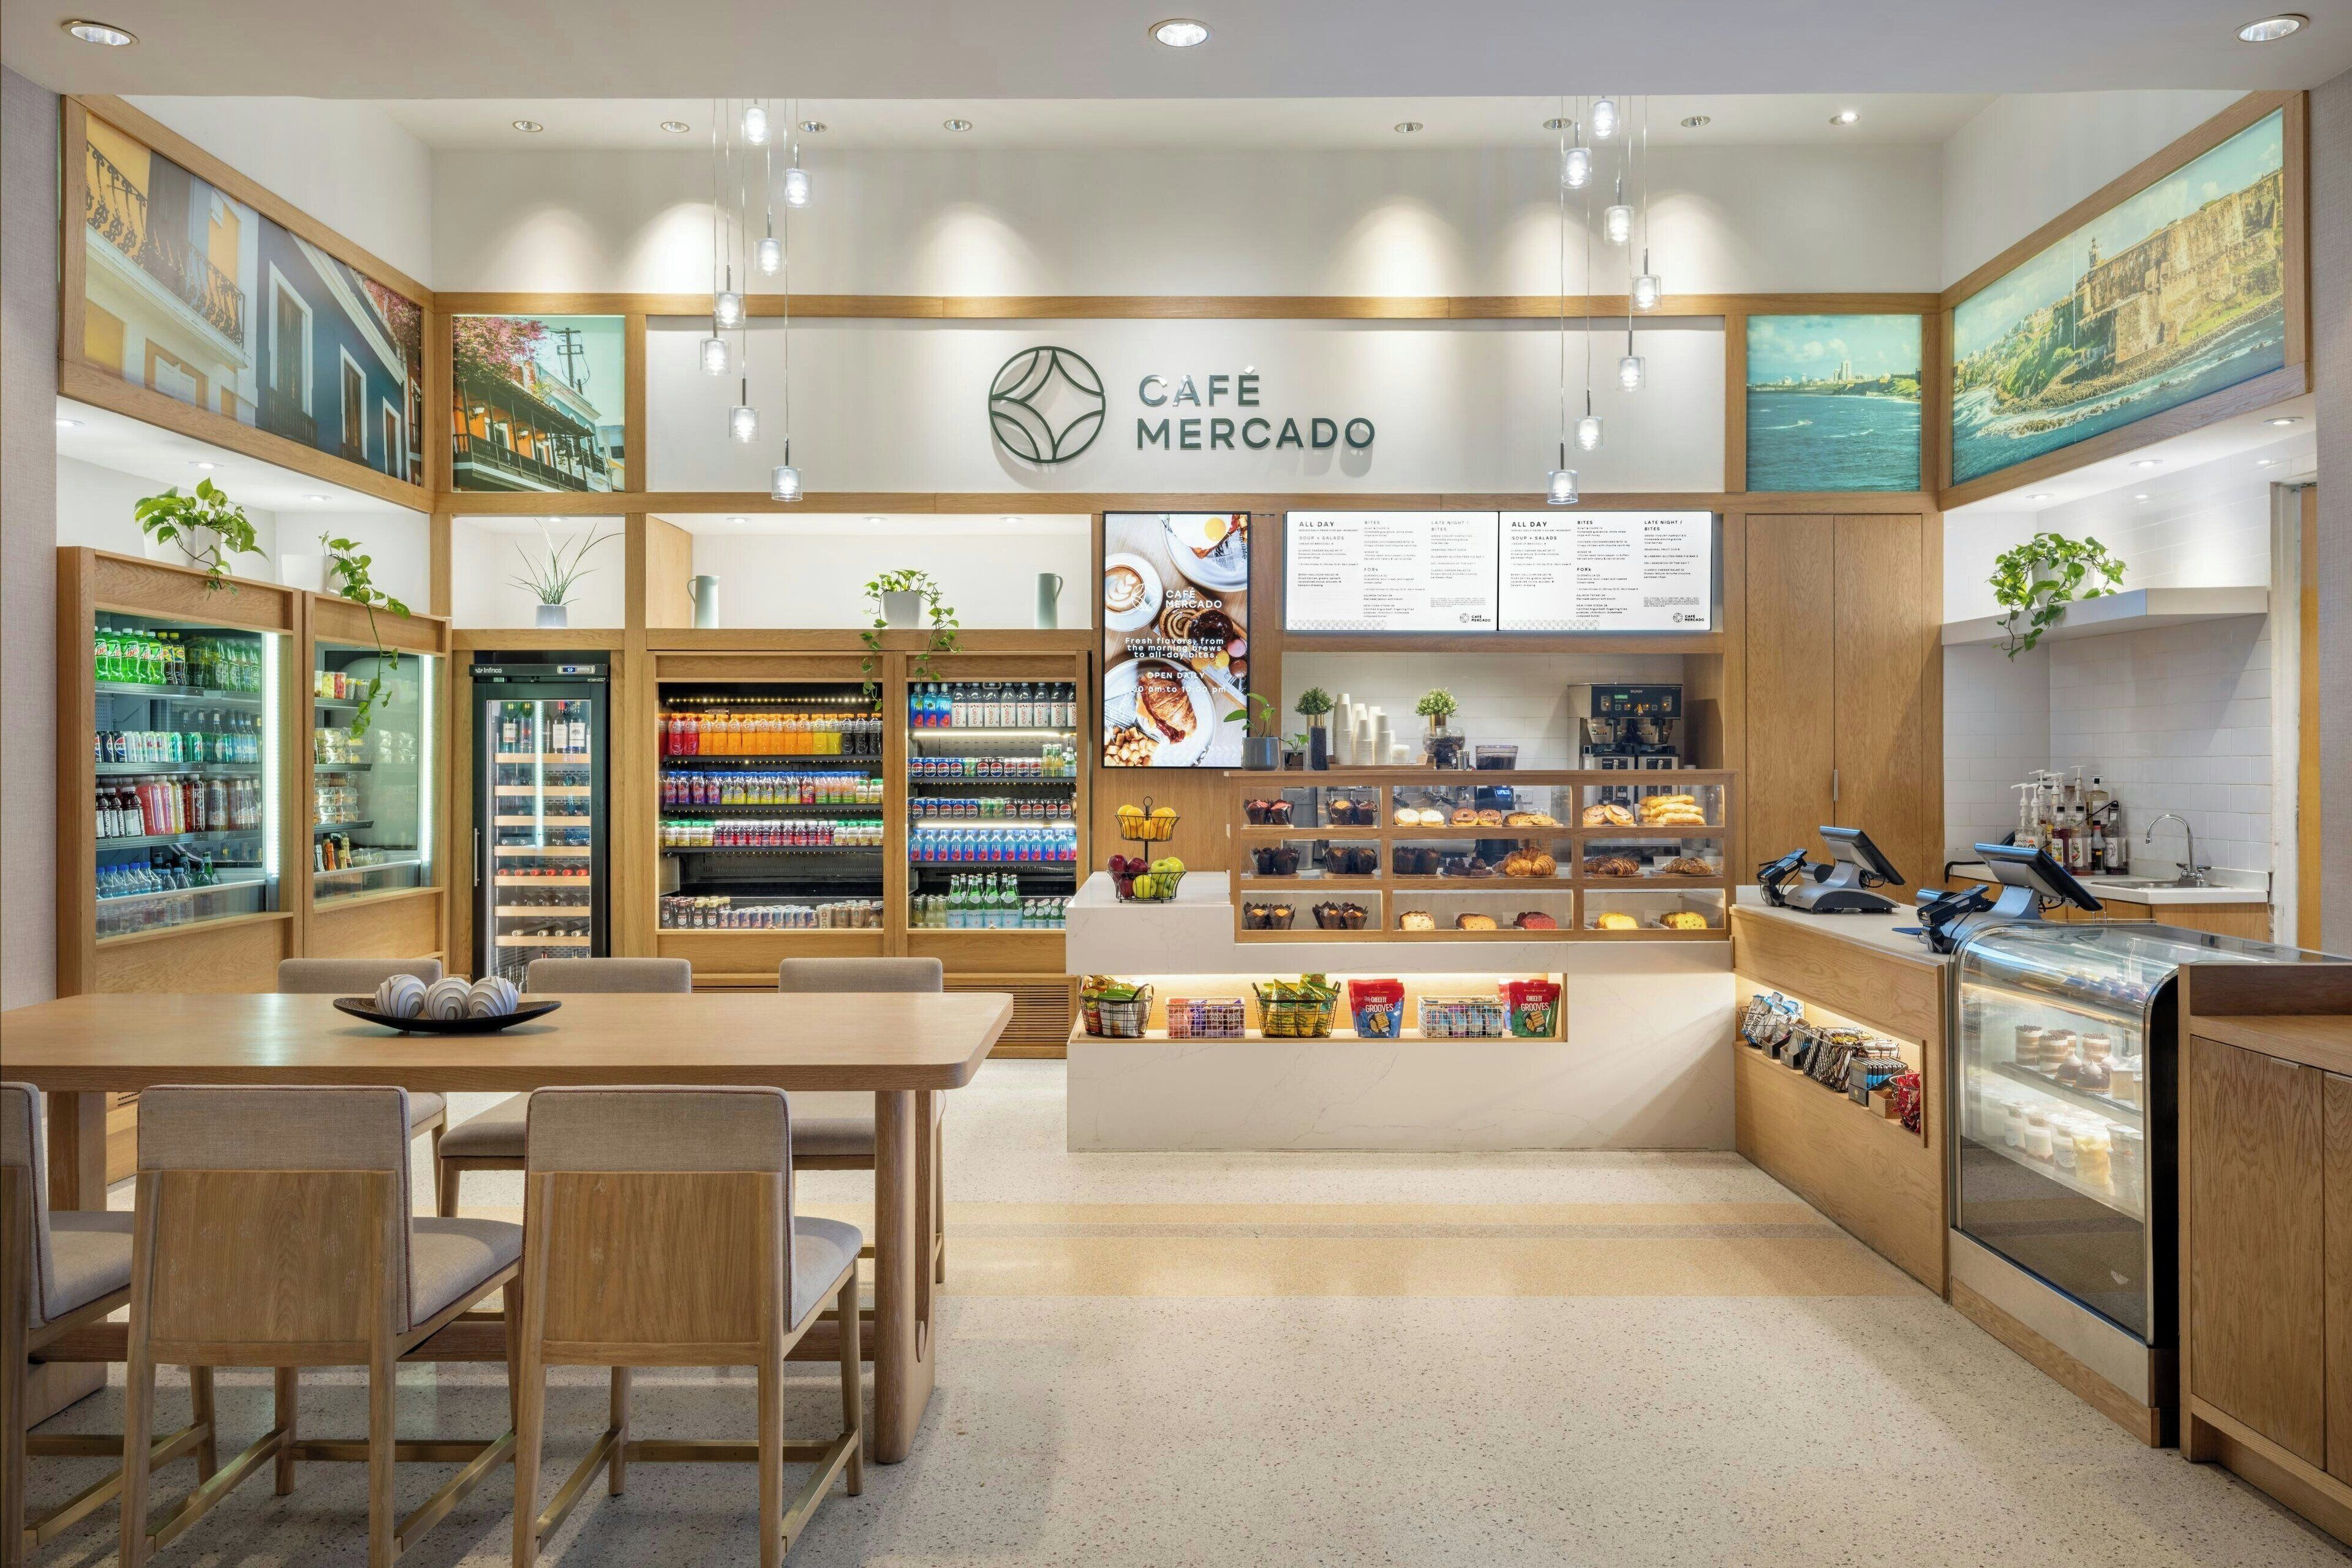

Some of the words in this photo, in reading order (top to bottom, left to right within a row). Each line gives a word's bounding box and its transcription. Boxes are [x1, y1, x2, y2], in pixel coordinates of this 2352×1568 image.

[1138, 365, 1260, 407] CAFÉ
[1137, 417, 1376, 450] MERCADO
[1166, 587, 1196, 598] CAFÉ
[1149, 651, 1185, 660] all-day
[1365, 1003, 1394, 1013] GROOVES
[1521, 1002, 1550, 1012] GROOVES
